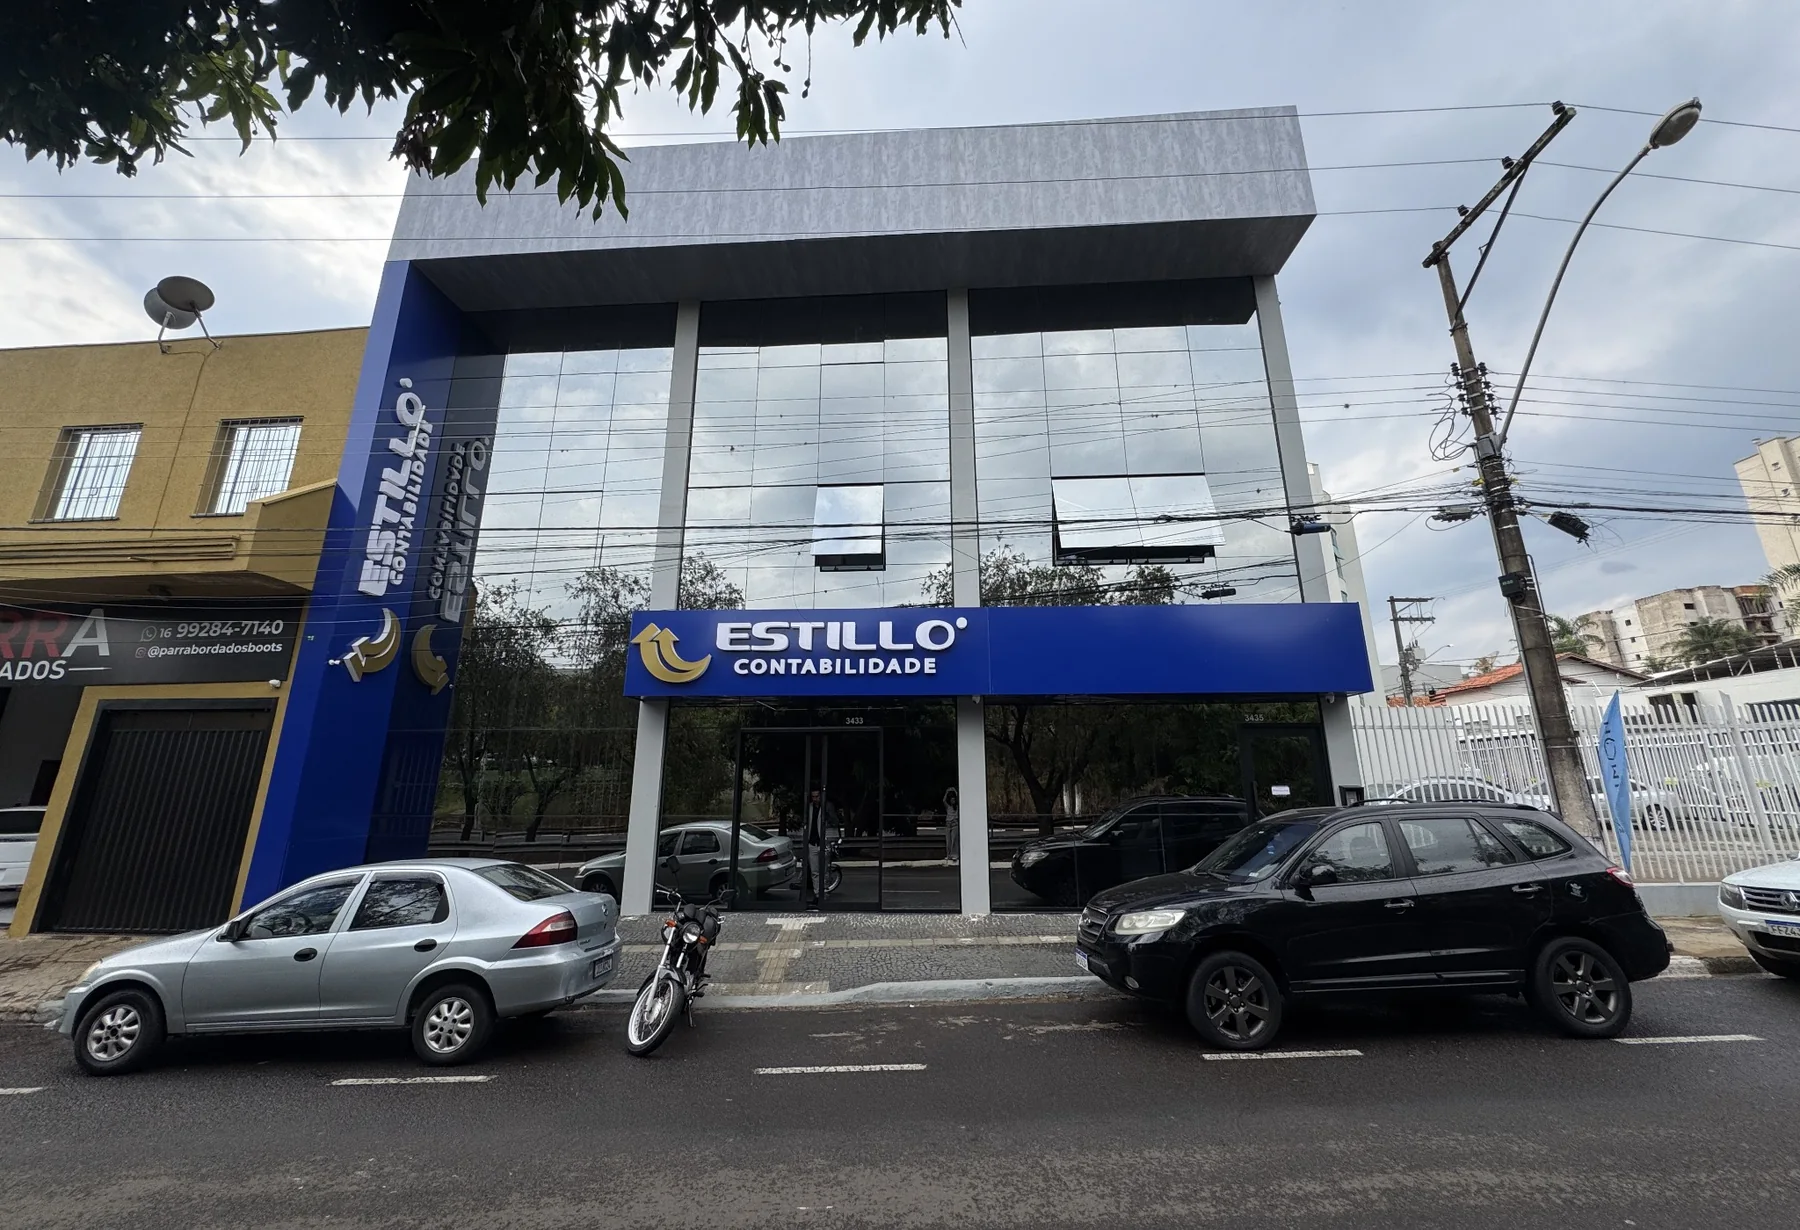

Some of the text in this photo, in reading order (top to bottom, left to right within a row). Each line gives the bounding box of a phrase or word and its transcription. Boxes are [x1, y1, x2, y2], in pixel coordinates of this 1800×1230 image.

[358, 391, 426, 597] ESTILLO
[159, 619, 284, 638] 16 99284-7140
[716, 619, 956, 651] ESTILLO
[147, 642, 283, 658] @parrabordadosboots
[733, 657, 937, 675] CONTABILIDADE
[845, 717, 864, 725] 3433
[1244, 714, 1264, 722] 3435
